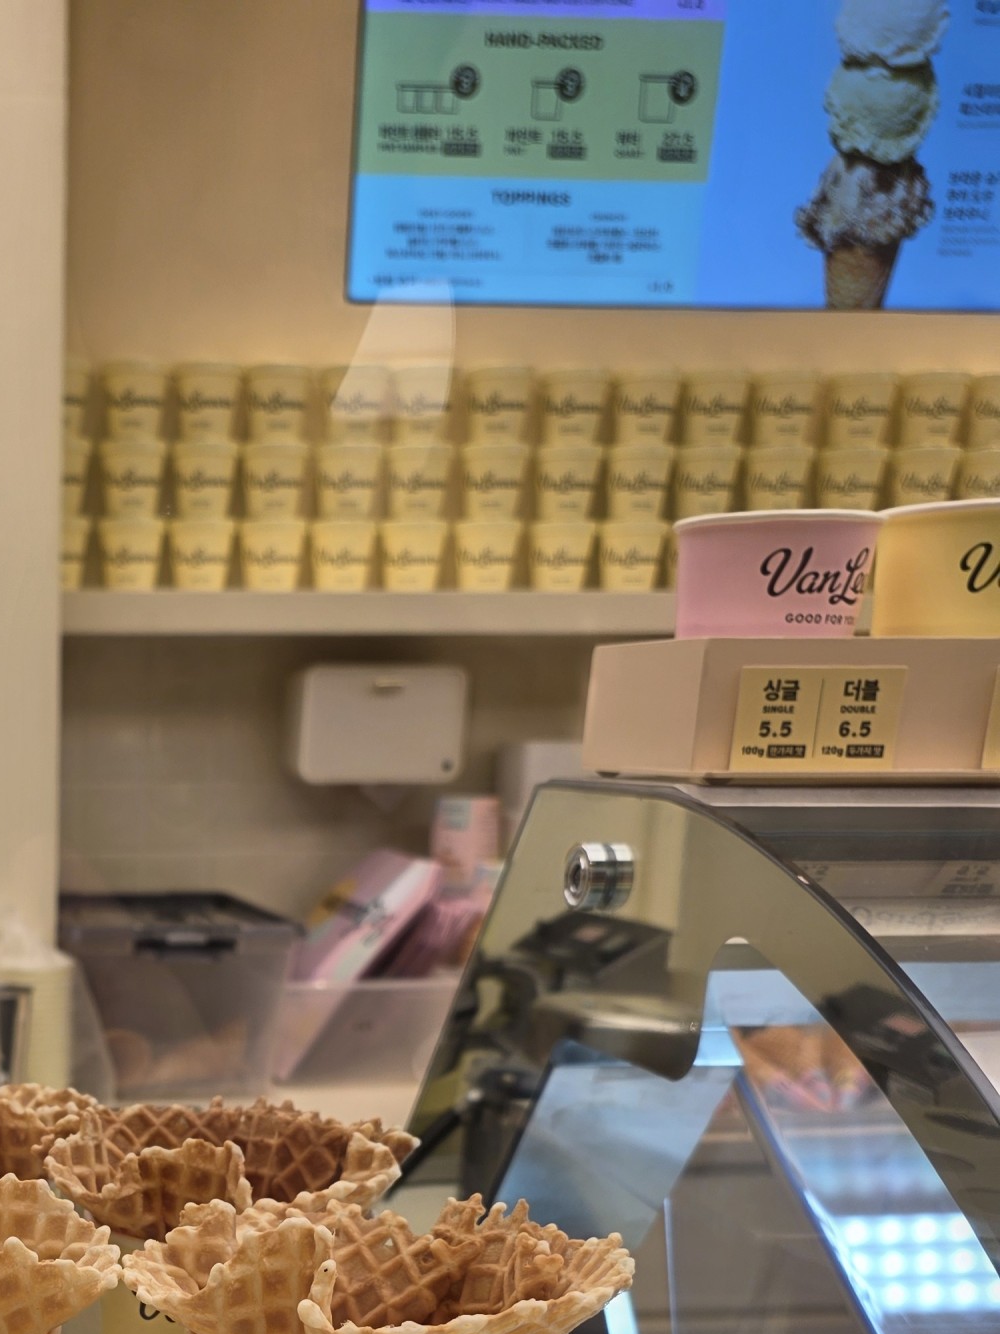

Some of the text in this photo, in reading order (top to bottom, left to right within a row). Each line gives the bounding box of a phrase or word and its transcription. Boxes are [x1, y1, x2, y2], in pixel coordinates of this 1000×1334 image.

[759, 546, 842, 598] Van
[785, 612, 822, 625] GOOD
[824, 613, 843, 626] FOR
[763, 678, 800, 702] 싱글
[843, 678, 880, 702] 더블
[762, 705, 795, 714] SINGLE
[840, 705, 876, 714] DOUBLE
[758, 720, 792, 738] 5.5
[838, 720, 872, 738] 6.5
[741, 745, 765, 758] 100g
[821, 745, 845, 758] 120g
